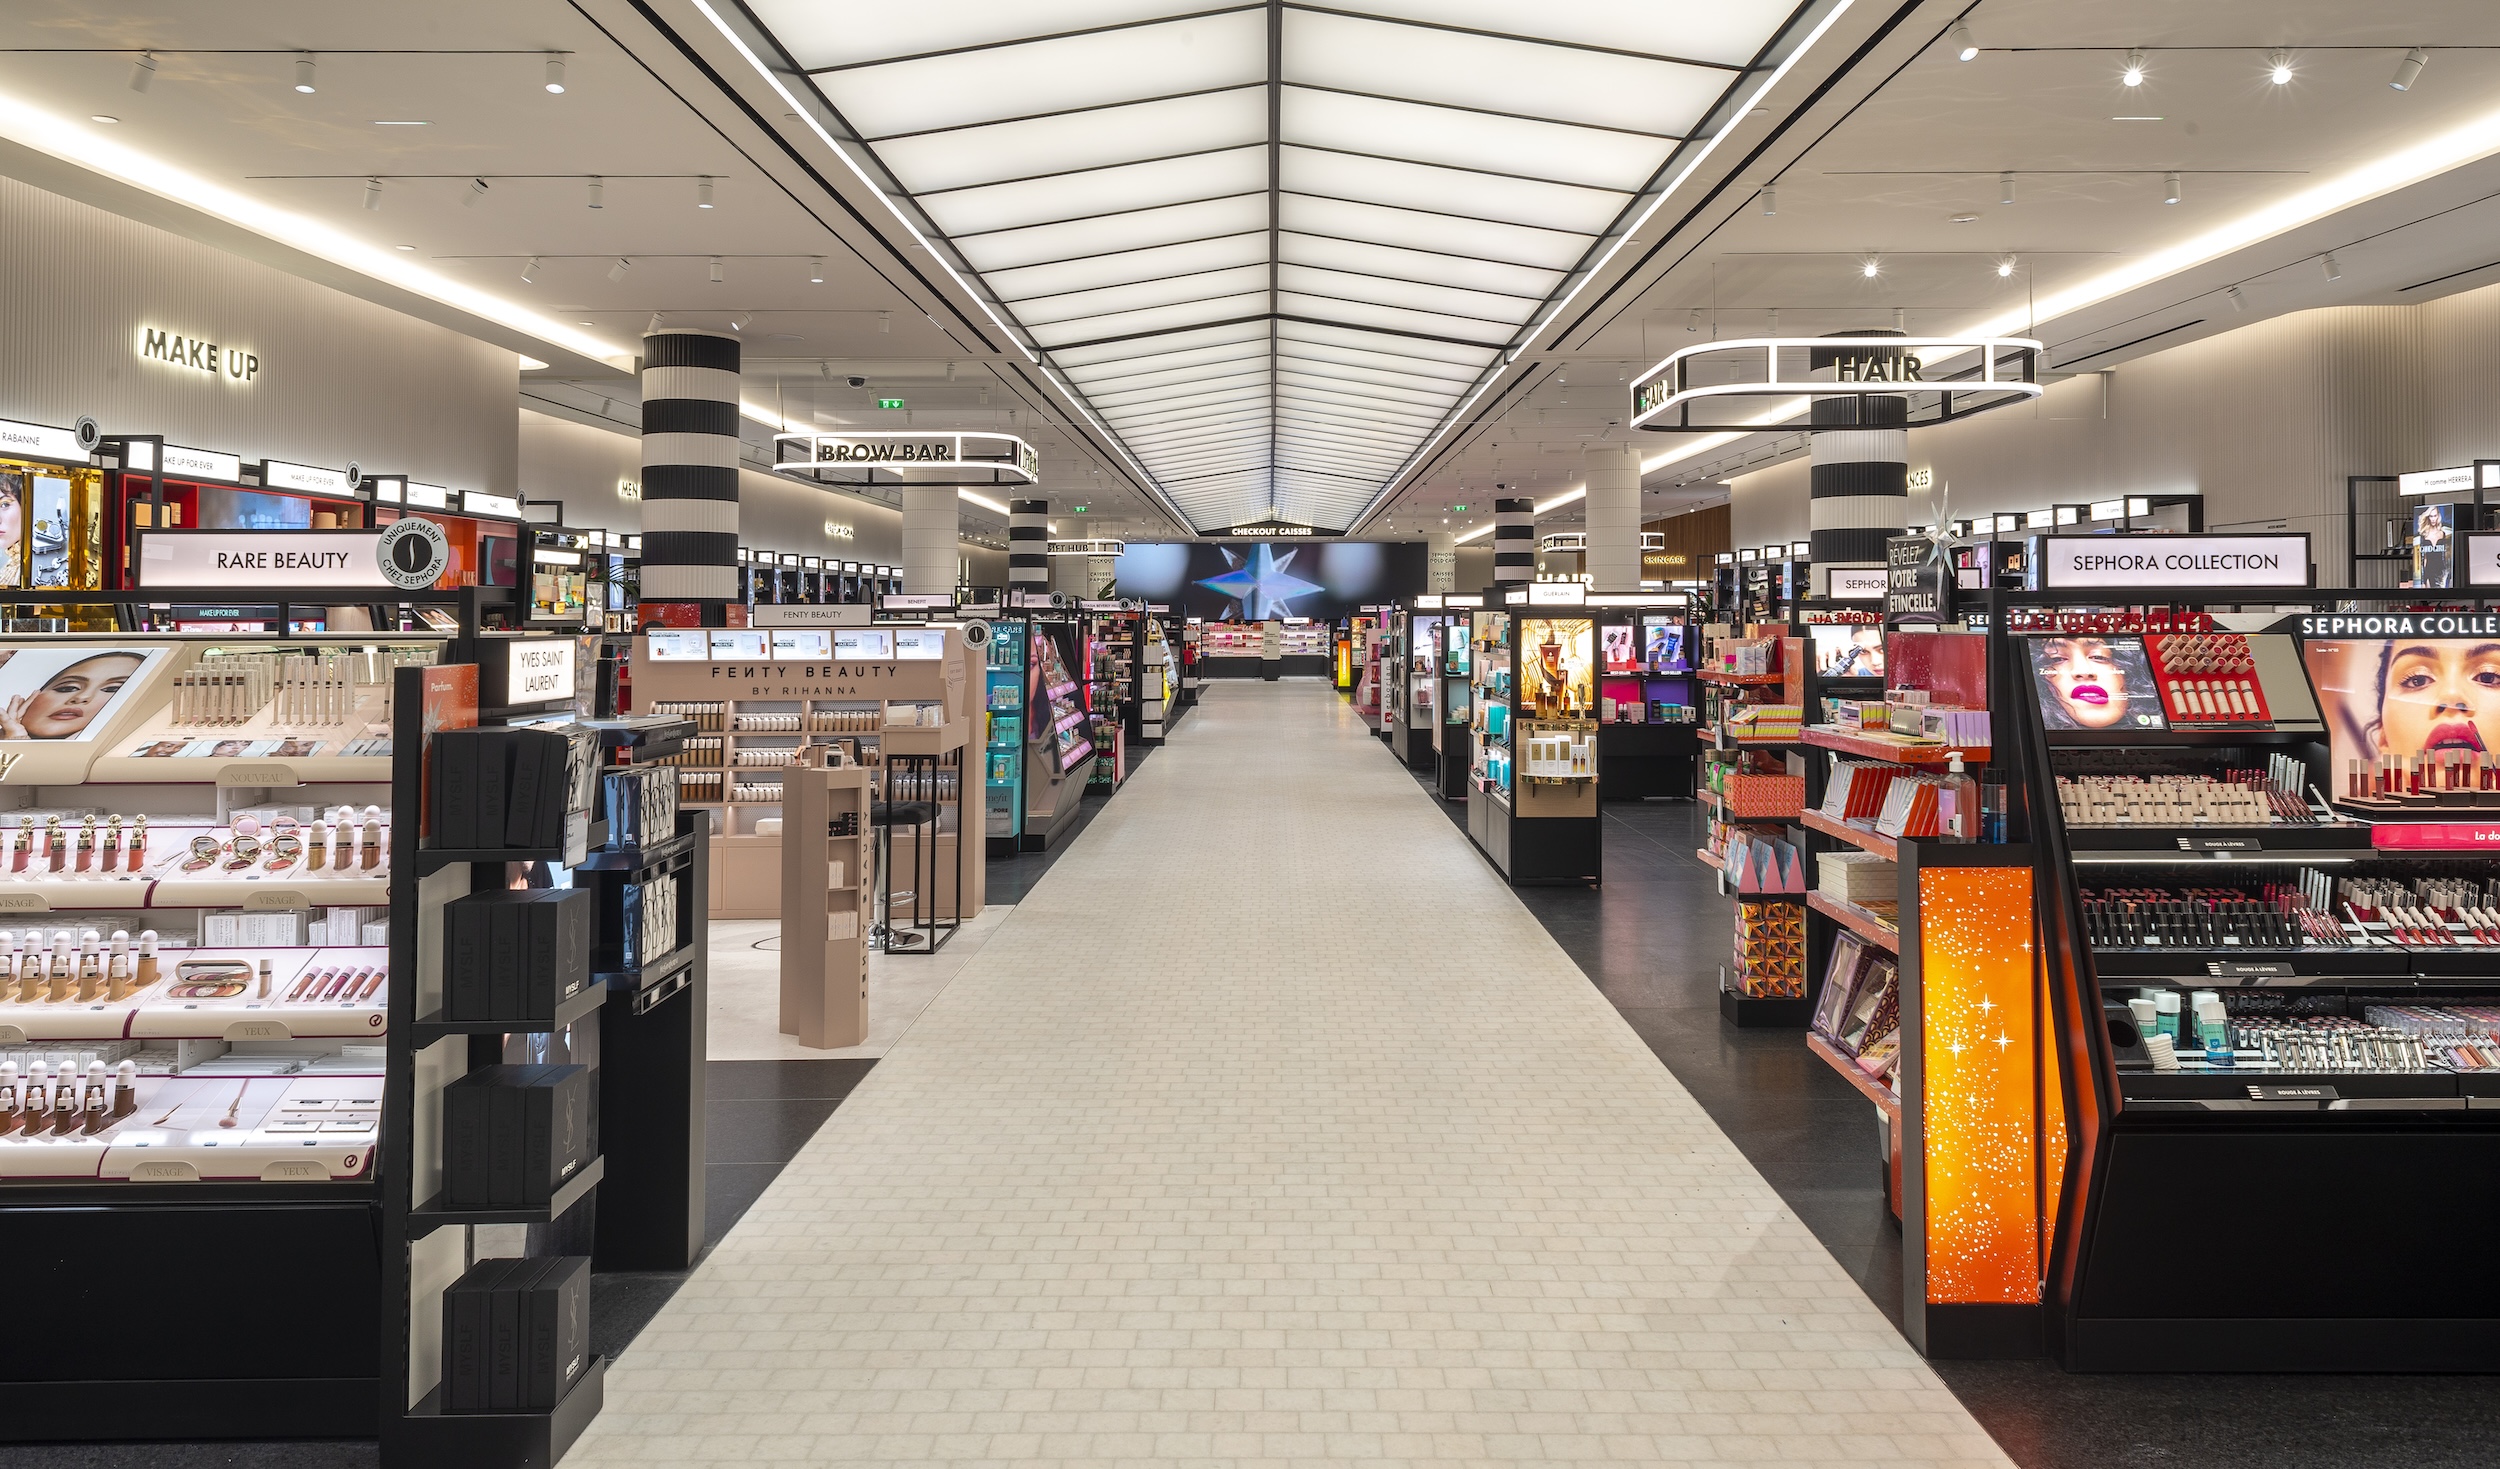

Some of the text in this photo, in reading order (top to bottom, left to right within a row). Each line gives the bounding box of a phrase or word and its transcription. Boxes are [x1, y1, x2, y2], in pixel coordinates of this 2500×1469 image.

[144, 328, 259, 381] MAKE UP
[1835, 356, 1923, 382] HAIR
[1645, 380, 1668, 411] HAIR
[2, 432, 40, 446] RABANNE
[822, 444, 949, 462] BROW BAR
[164, 457, 213, 470] AKE UP FOR EVER
[2448, 475, 2473, 484] HERRERA
[621, 481, 637, 498] MEN
[383, 522, 442, 546] UNIQUEMENT
[1232, 527, 1312, 536] CHECKOUT CAISSES
[217, 552, 349, 569] RARE BEAUTY
[1644, 555, 1686, 564] SKINCARE
[1889, 542, 1920, 567] RÉVÉLEZ
[2073, 553, 2279, 572] SEPHORA COLLECTION
[382, 556, 443, 585] CHEZ SEPHORA
[1889, 569, 1918, 588] VOTRE
[1845, 579, 1887, 589] SEPHOR
[1890, 591, 1936, 613] ÉTINCELLE.
[199, 609, 240, 617] MAKE UP FOR EVER
[783, 610, 842, 619] FENTY BEAUTY
[2302, 617, 2500, 634] SEPHORA COLLE
[520, 649, 564, 669] YVES SAINT
[806, 666, 897, 678] BEAUTY
[430, 682, 453, 693] Parfum.
[525, 674, 560, 694] LAURENT
[753, 686, 857, 695] BY RIHANNA
[230, 773, 283, 783] NOUVEAU
[515, 762, 533, 813] MYSLF
[450, 765, 464, 816] MYSLF
[486, 764, 499, 816] MYSLF
[986, 790, 1007, 802] enefit
[2475, 831, 2485, 840] La
[259, 896, 295, 905] VISAGE
[461, 935, 474, 990] MYSLF
[498, 935, 511, 988] MYSLF
[537, 935, 550, 987] MYSLF
[244, 1027, 271, 1036] YEUX
[533, 1120, 547, 1172] MYSLF
[146, 1168, 184, 1177] VISAGE
[282, 1167, 310, 1176] YEUX
[561, 1158, 577, 1177] MYSLF
[460, 1325, 473, 1376] MYSLF
[499, 1323, 512, 1375] MYSLF
[537, 1323, 549, 1374] MYSLF
[565, 1354, 581, 1377] MYSLF
